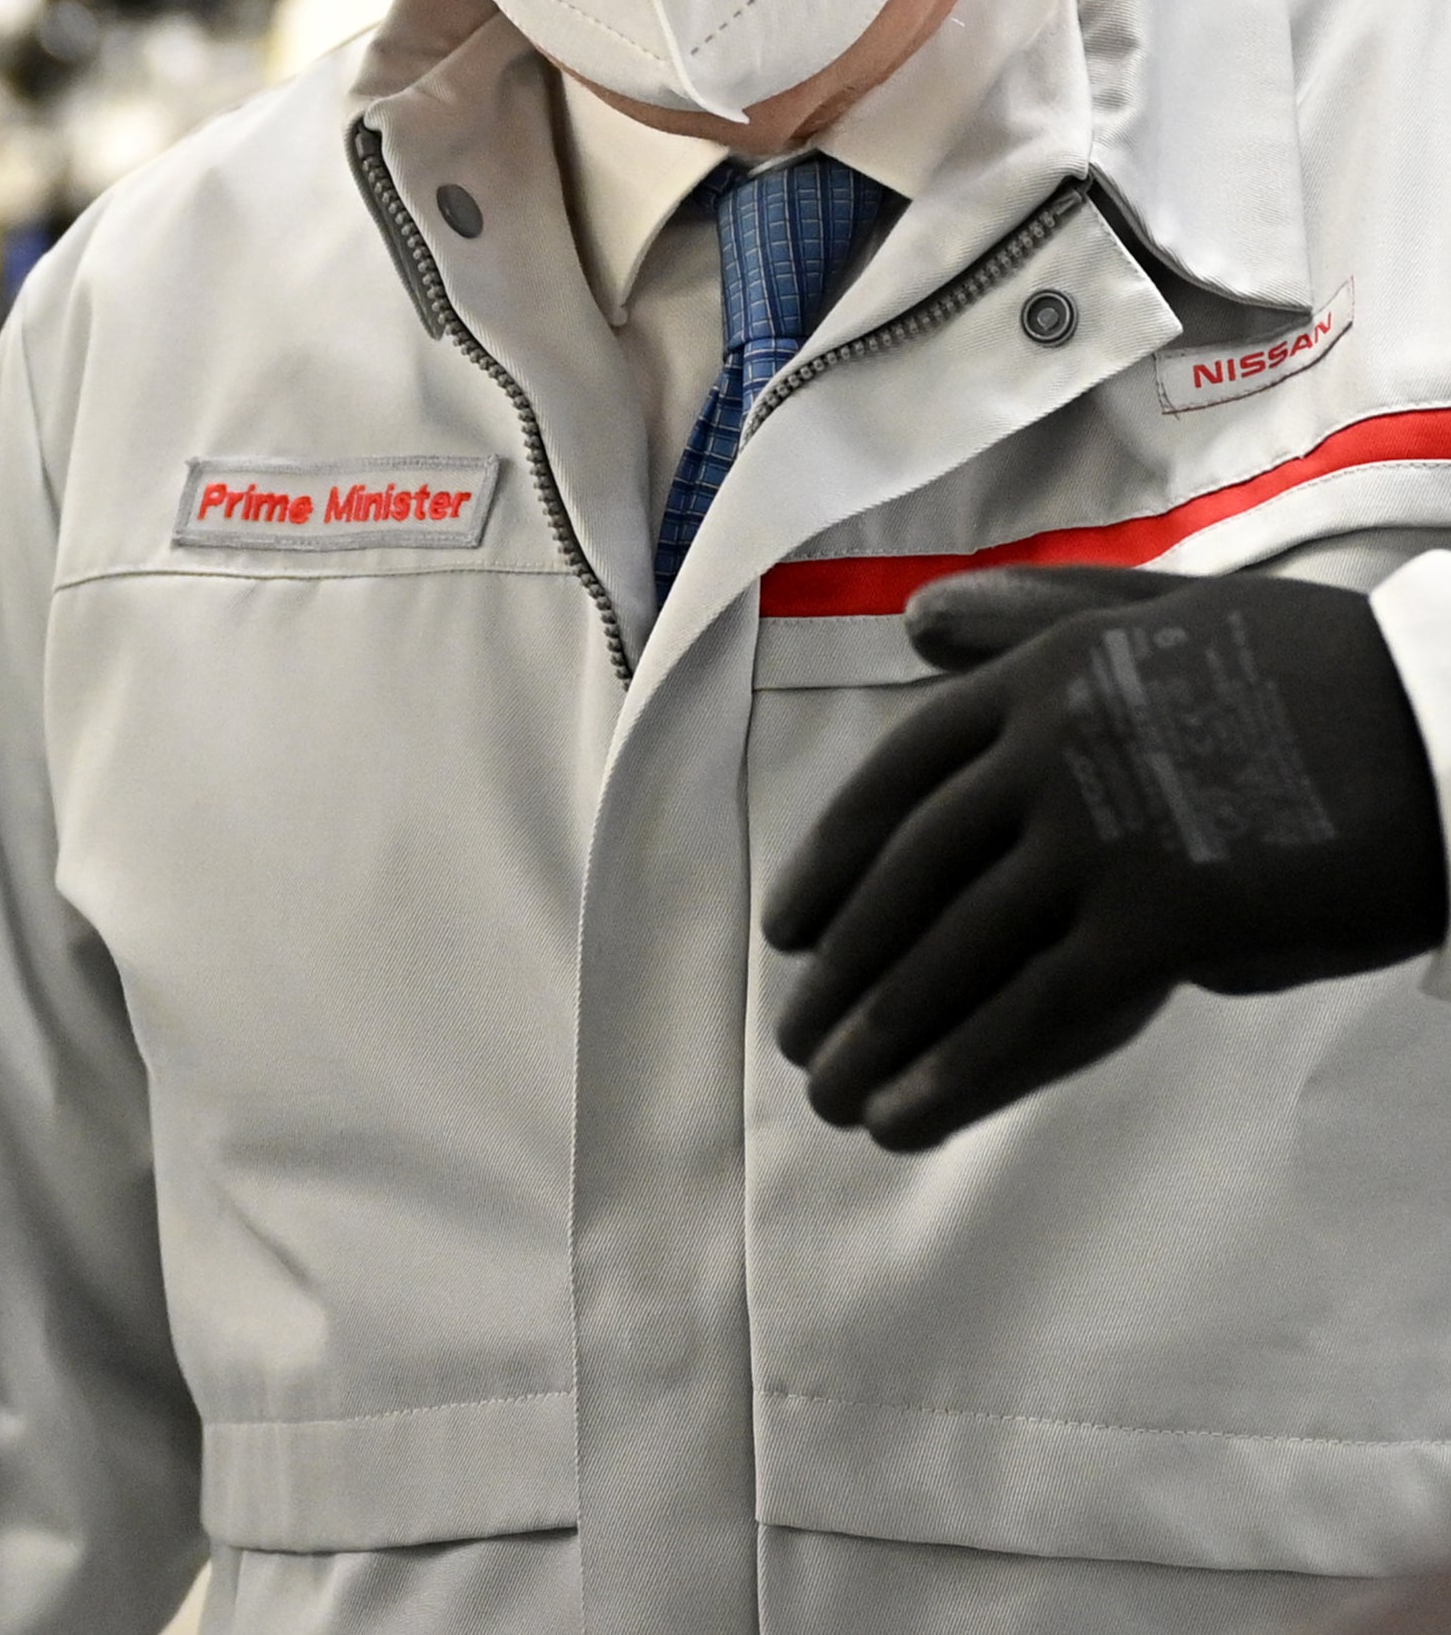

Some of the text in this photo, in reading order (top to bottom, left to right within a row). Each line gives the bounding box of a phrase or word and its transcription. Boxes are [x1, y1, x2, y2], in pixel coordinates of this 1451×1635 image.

[1192, 311, 1333, 389] NISSAN
[197, 481, 472, 525] Prime Minister
